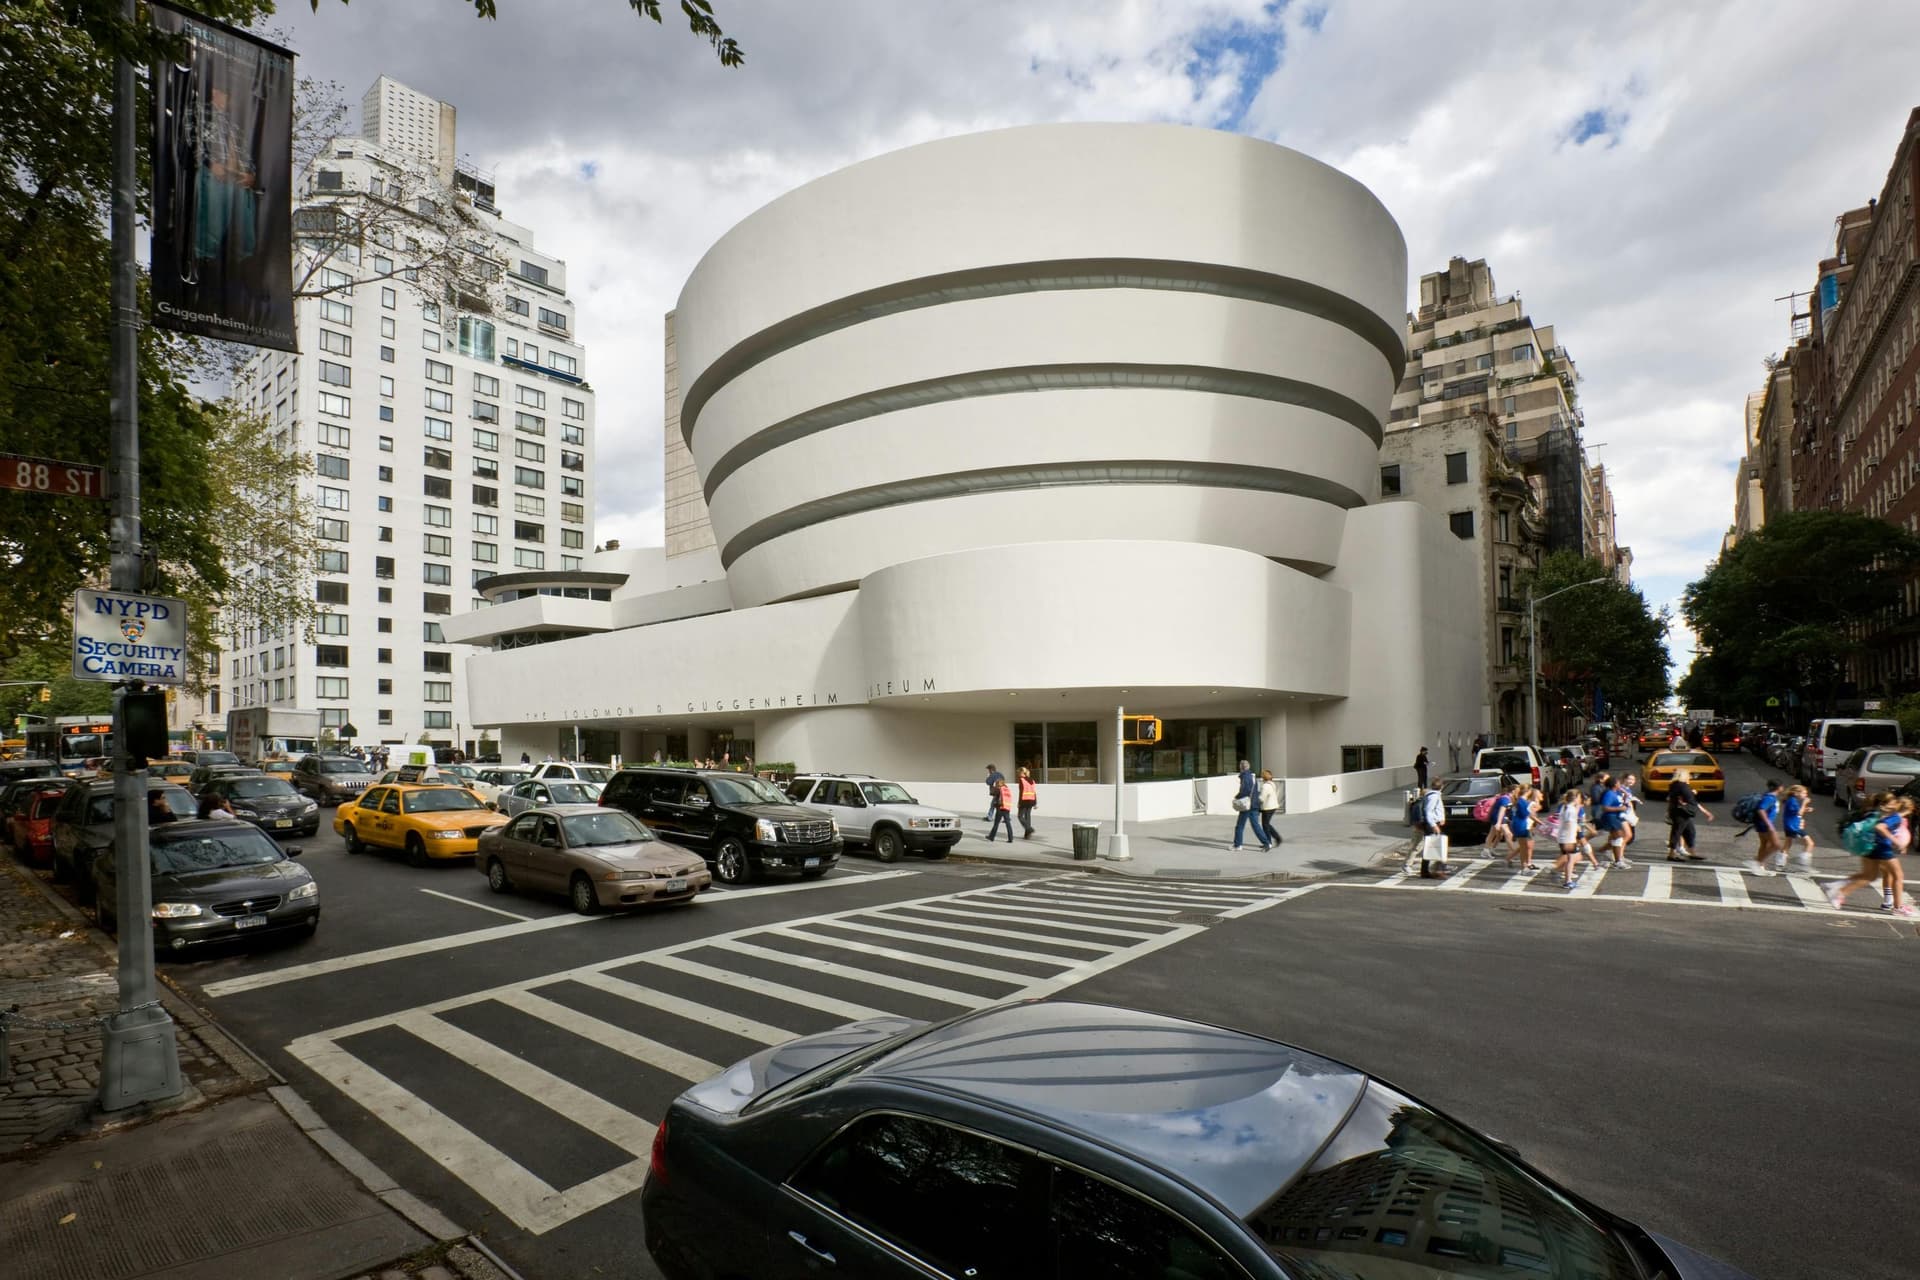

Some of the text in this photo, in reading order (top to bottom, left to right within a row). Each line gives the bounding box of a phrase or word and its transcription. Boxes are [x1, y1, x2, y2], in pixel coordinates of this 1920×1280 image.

[16, 461, 94, 495] 88 ST
[95, 597, 170, 620] NYPD
[78, 636, 182, 661] SECURITY
[83, 655, 176, 678] CAMERA
[526, 712, 547, 721] THE
[687, 693, 838, 712] GUGGENHEIM
